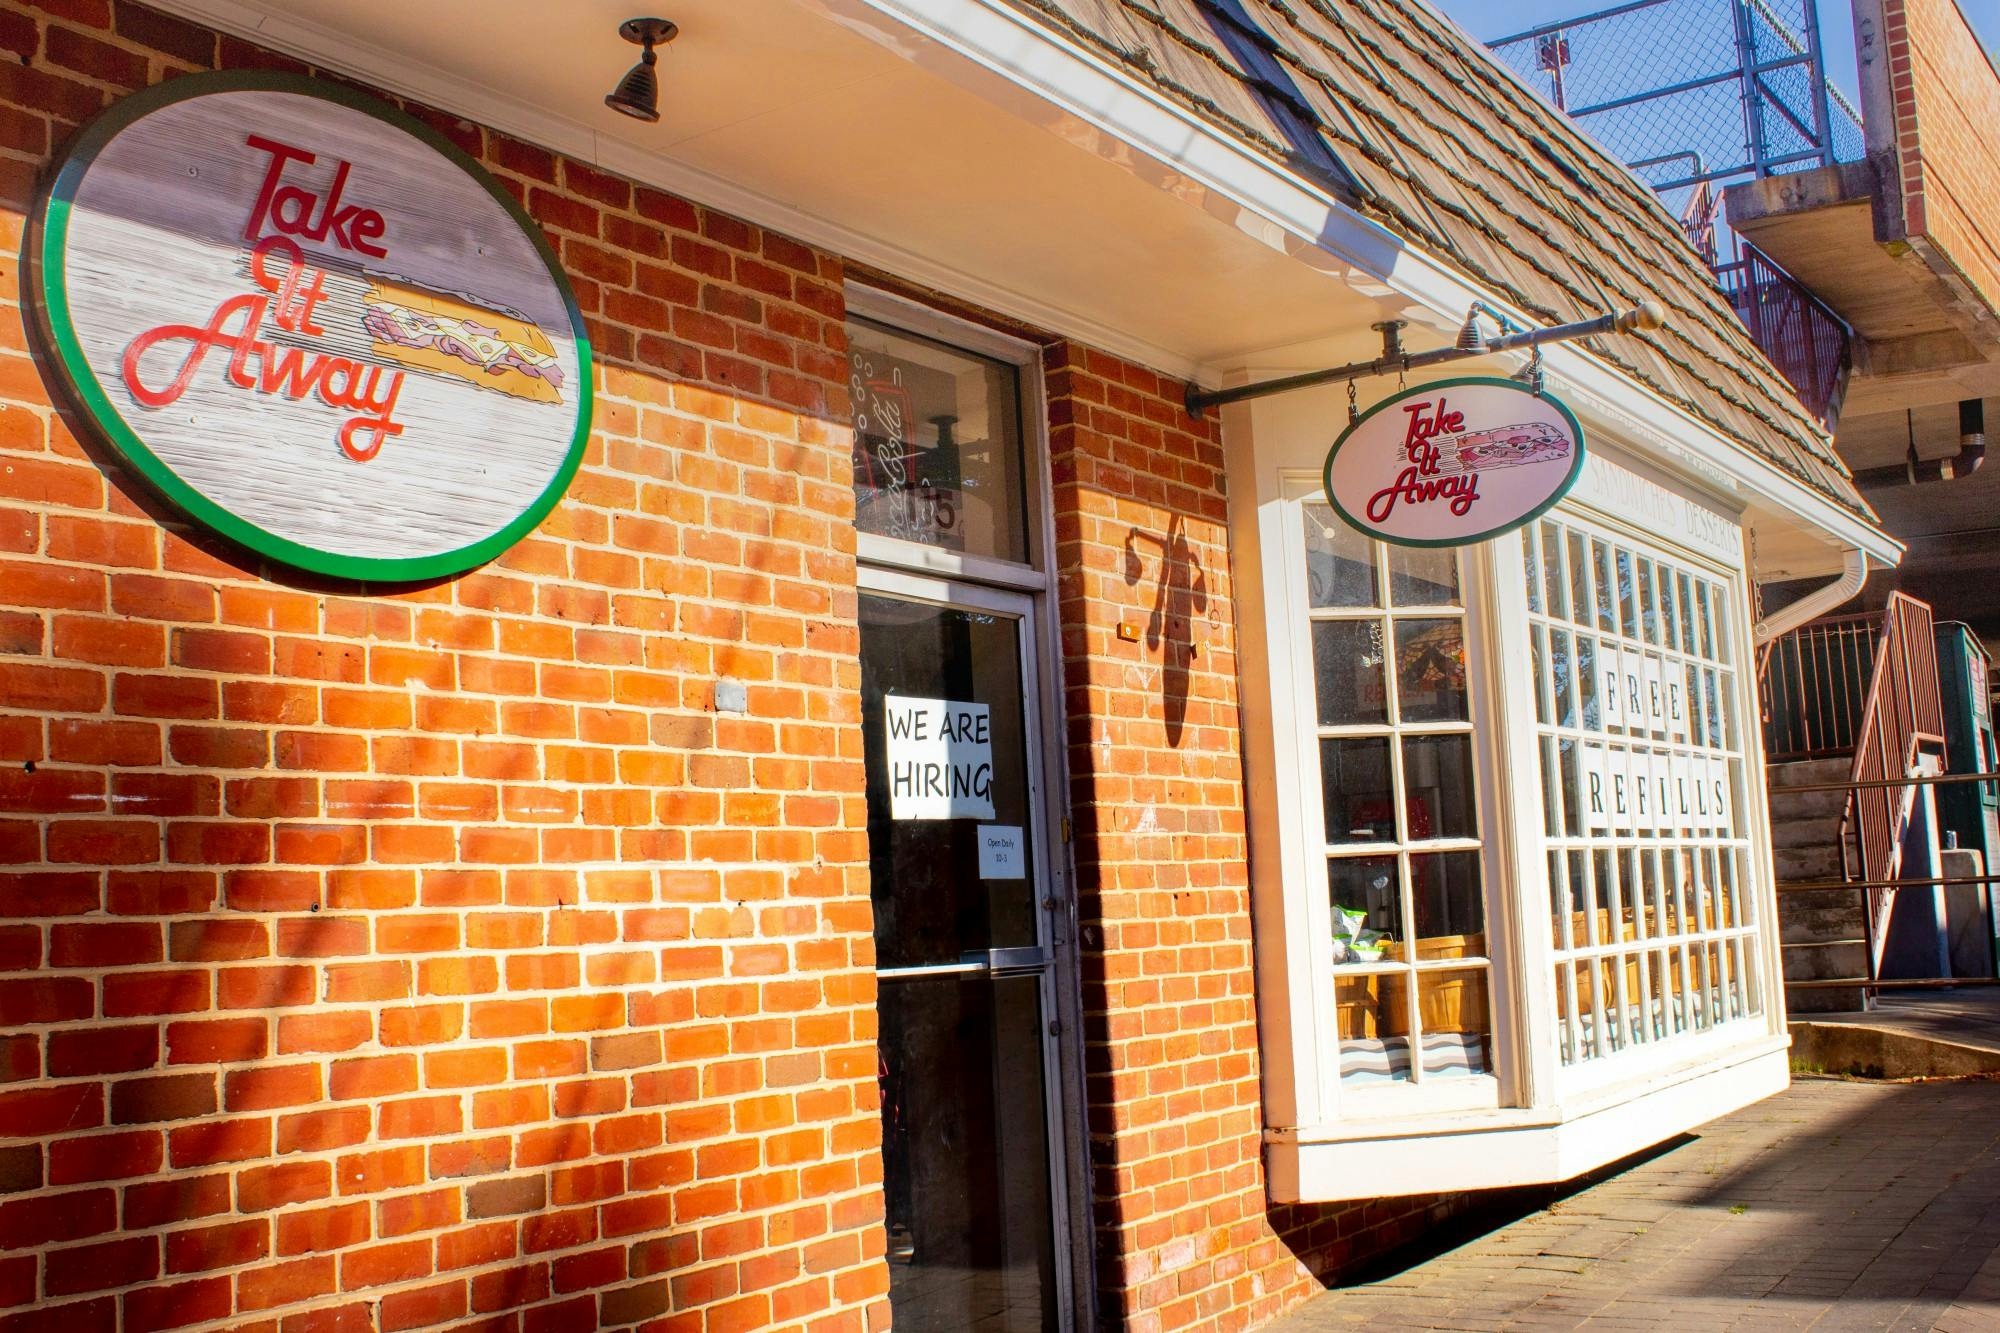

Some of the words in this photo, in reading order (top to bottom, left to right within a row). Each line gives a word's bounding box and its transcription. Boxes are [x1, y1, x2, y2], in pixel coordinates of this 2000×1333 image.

[246, 135, 388, 258] Take
[251, 236, 326, 336] It
[122, 294, 405, 462] Away
[1403, 398, 1466, 448] Take
[1408, 439, 1442, 475] It
[1366, 467, 1480, 523] Away
[1684, 500, 1739, 556] DESSERTS
[1607, 671, 1680, 720] FREE
[888, 708, 928, 741] WE
[939, 711, 989, 744] ARE
[894, 760, 992, 803] HIRING
[1589, 771, 1723, 815] REFILLS
[987, 838, 1001, 848] Open
[1001, 838, 1015, 850] Daily
